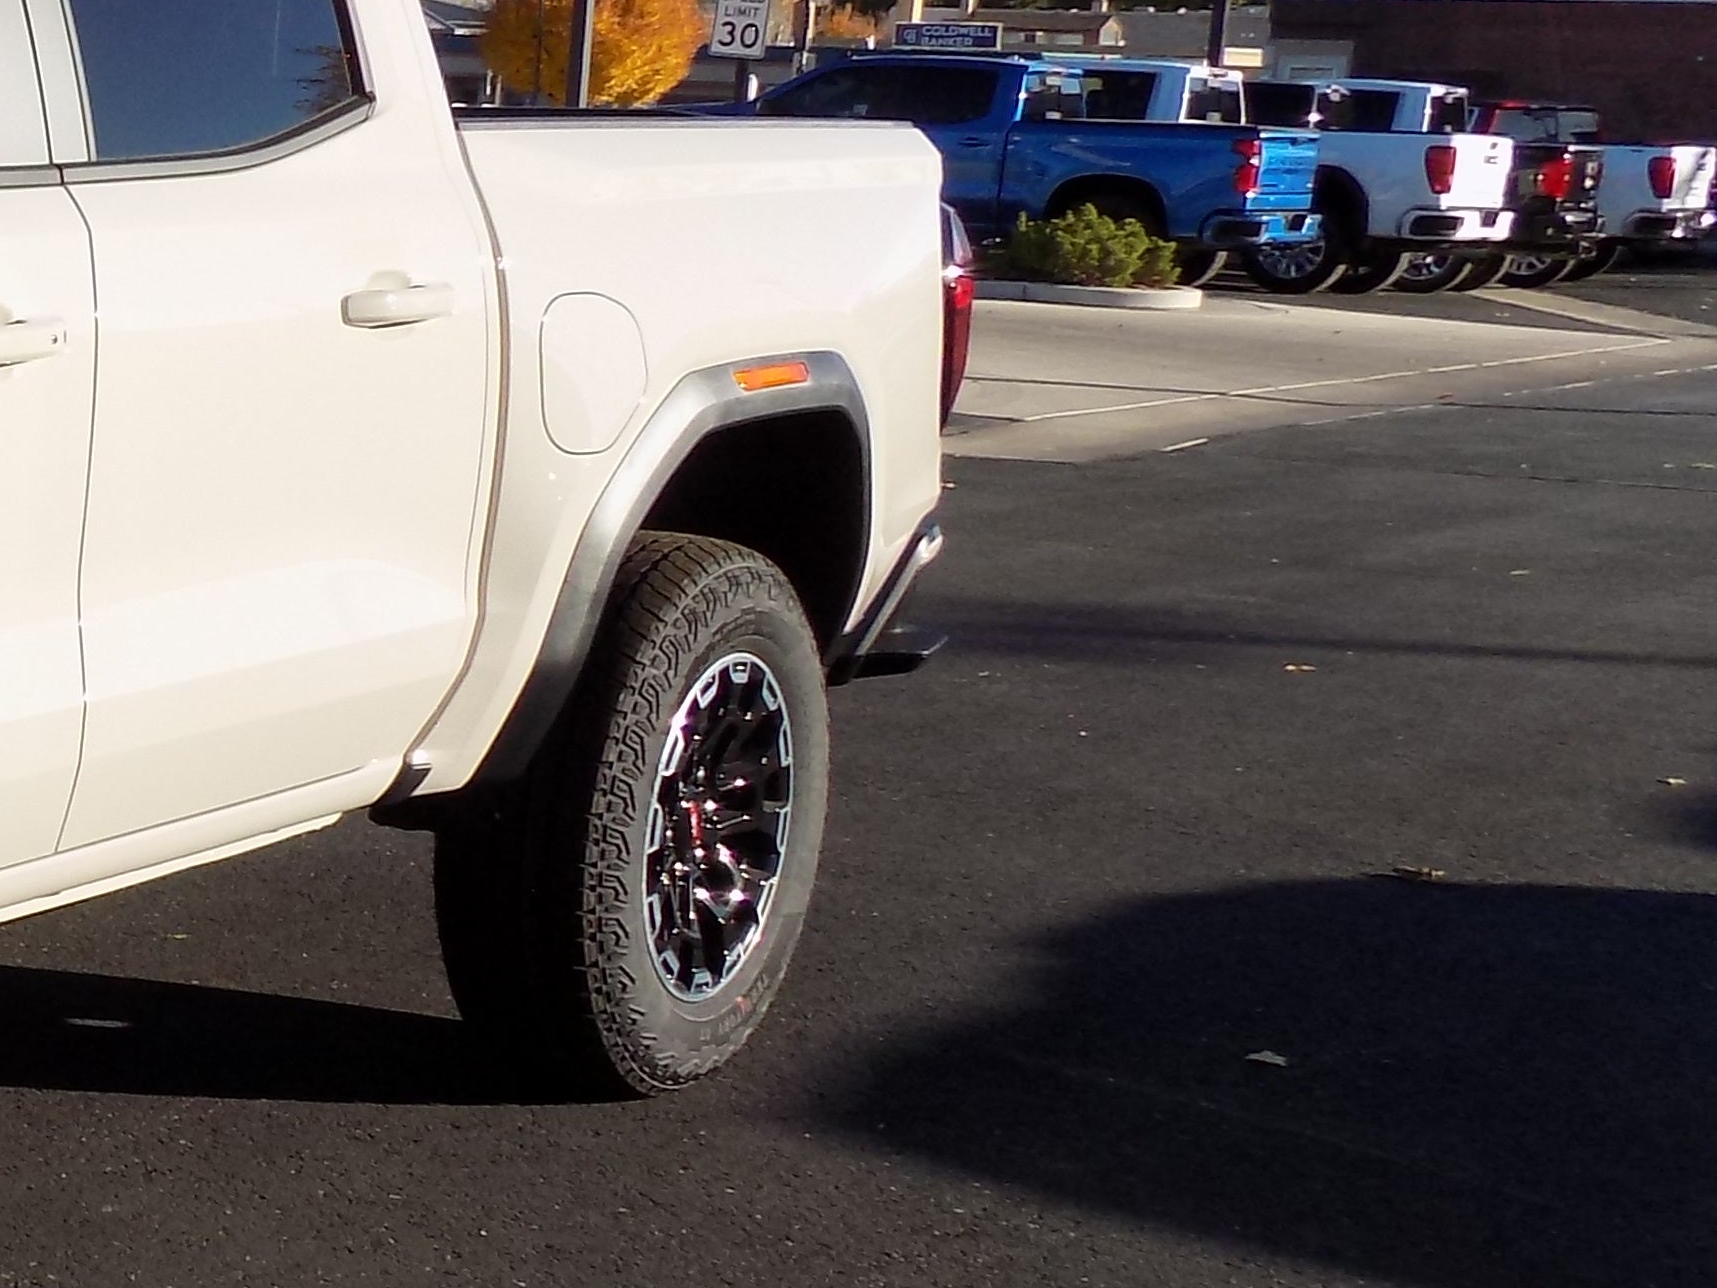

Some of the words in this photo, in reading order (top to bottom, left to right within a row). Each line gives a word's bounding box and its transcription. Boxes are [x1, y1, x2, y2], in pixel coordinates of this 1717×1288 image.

[724, 6, 761, 18] LIMIT
[717, 21, 760, 49] 30
[922, 26, 993, 37] COLDWELL
[920, 36, 974, 46] BANKER
